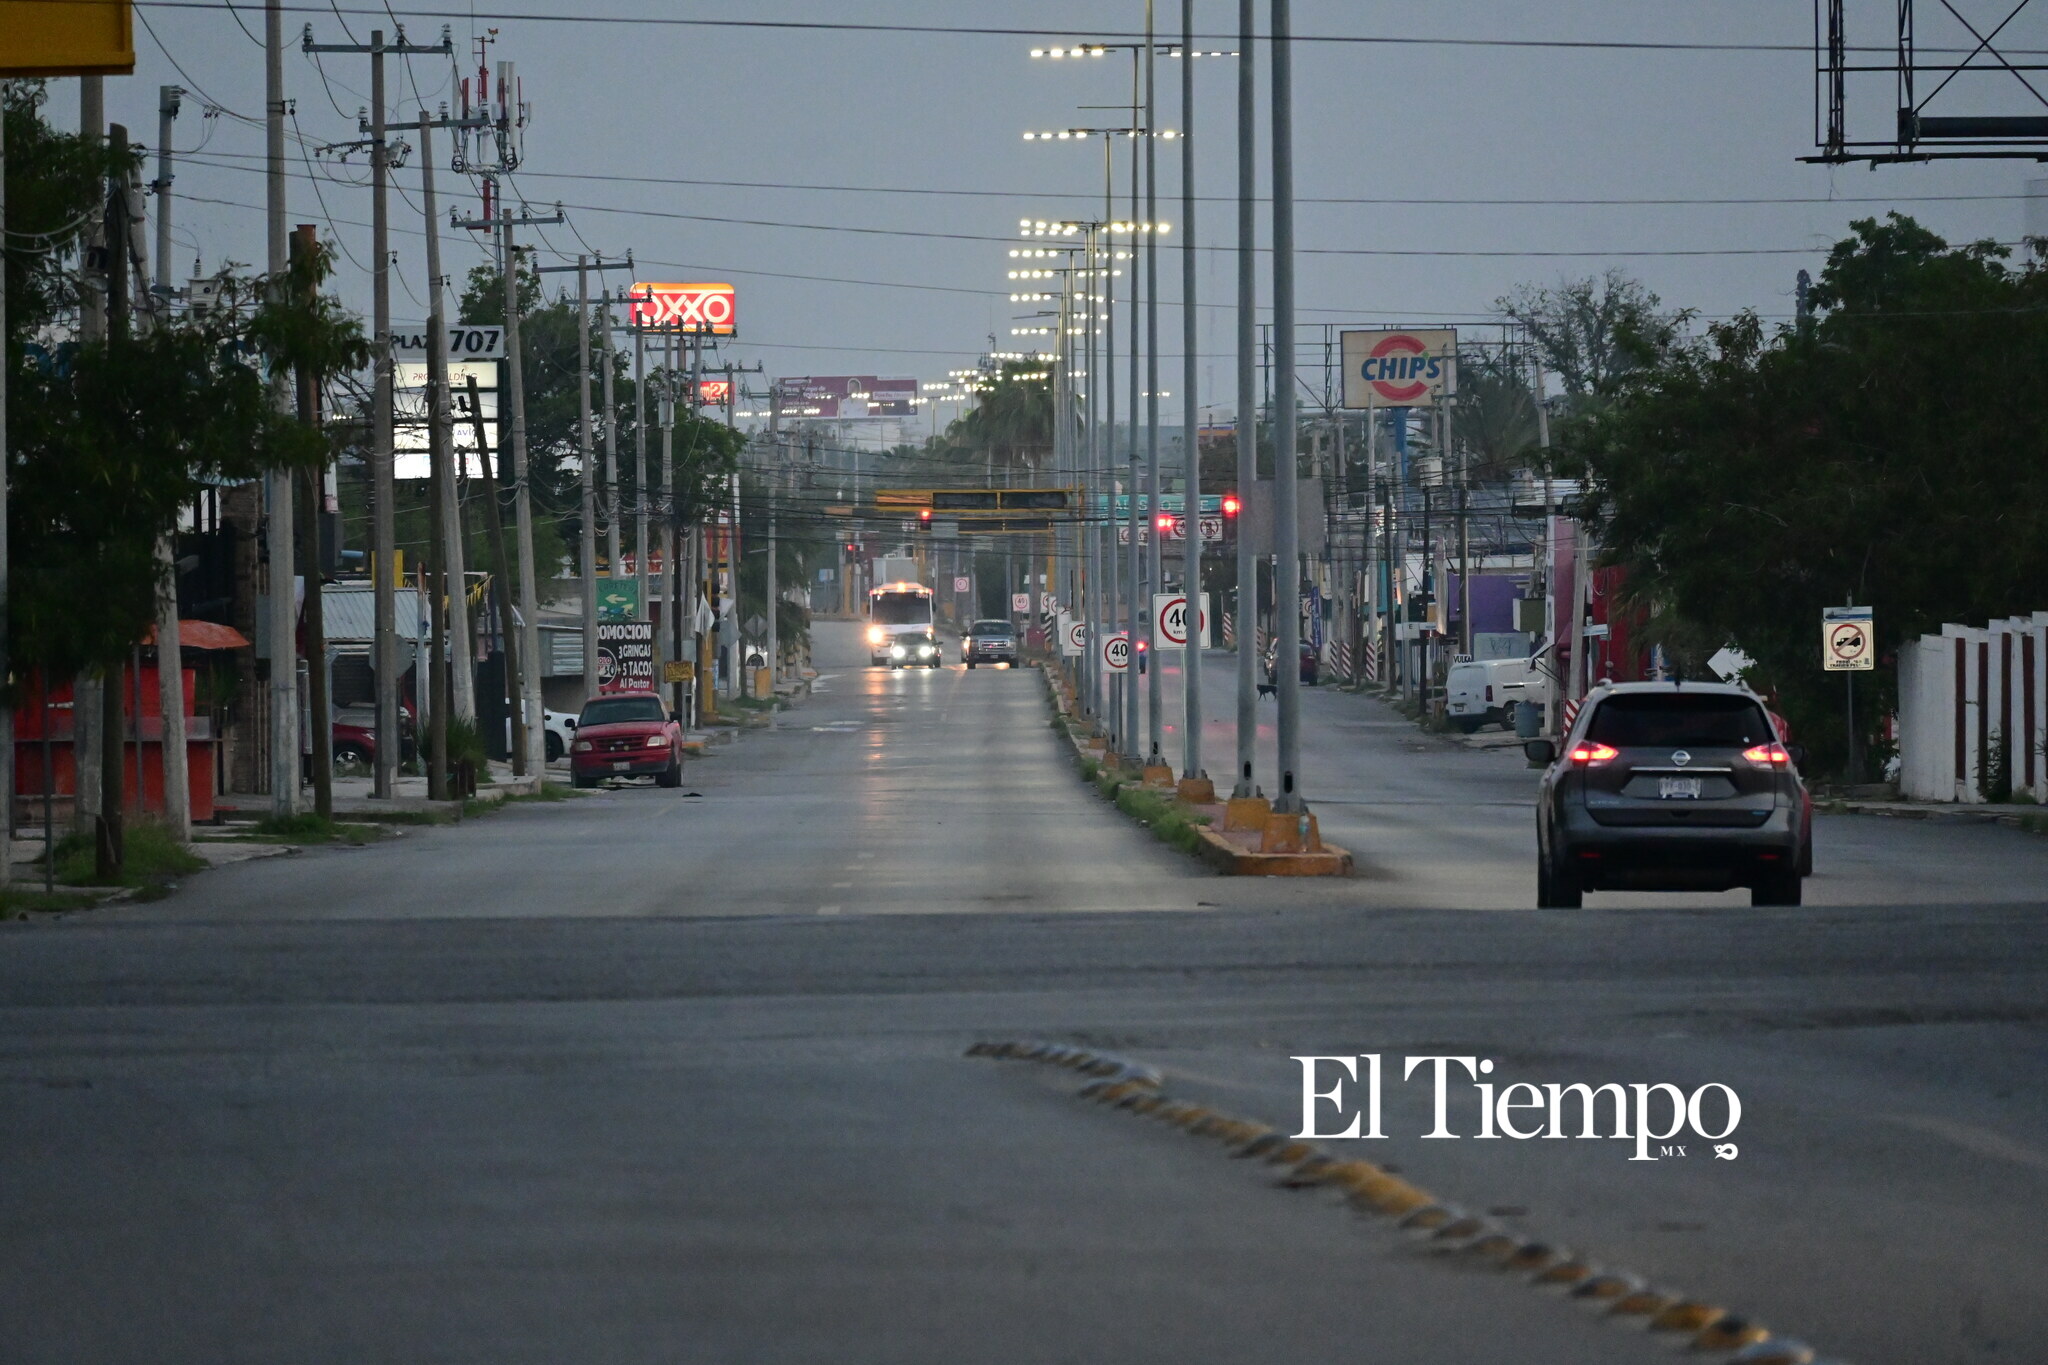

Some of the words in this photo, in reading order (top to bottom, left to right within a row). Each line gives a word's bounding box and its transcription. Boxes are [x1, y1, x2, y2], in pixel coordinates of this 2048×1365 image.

[636, 294, 731, 324] OXXO
[449, 330, 500, 353] 707
[618, 645, 624, 660] 3
[623, 644, 652, 658] GRINGAS
[1112, 643, 1128, 657] 40
[622, 662, 628, 677] 5
[628, 660, 653, 677] TACOS
[619, 677, 628, 689] Al
[628, 677, 651, 689] Pastor
